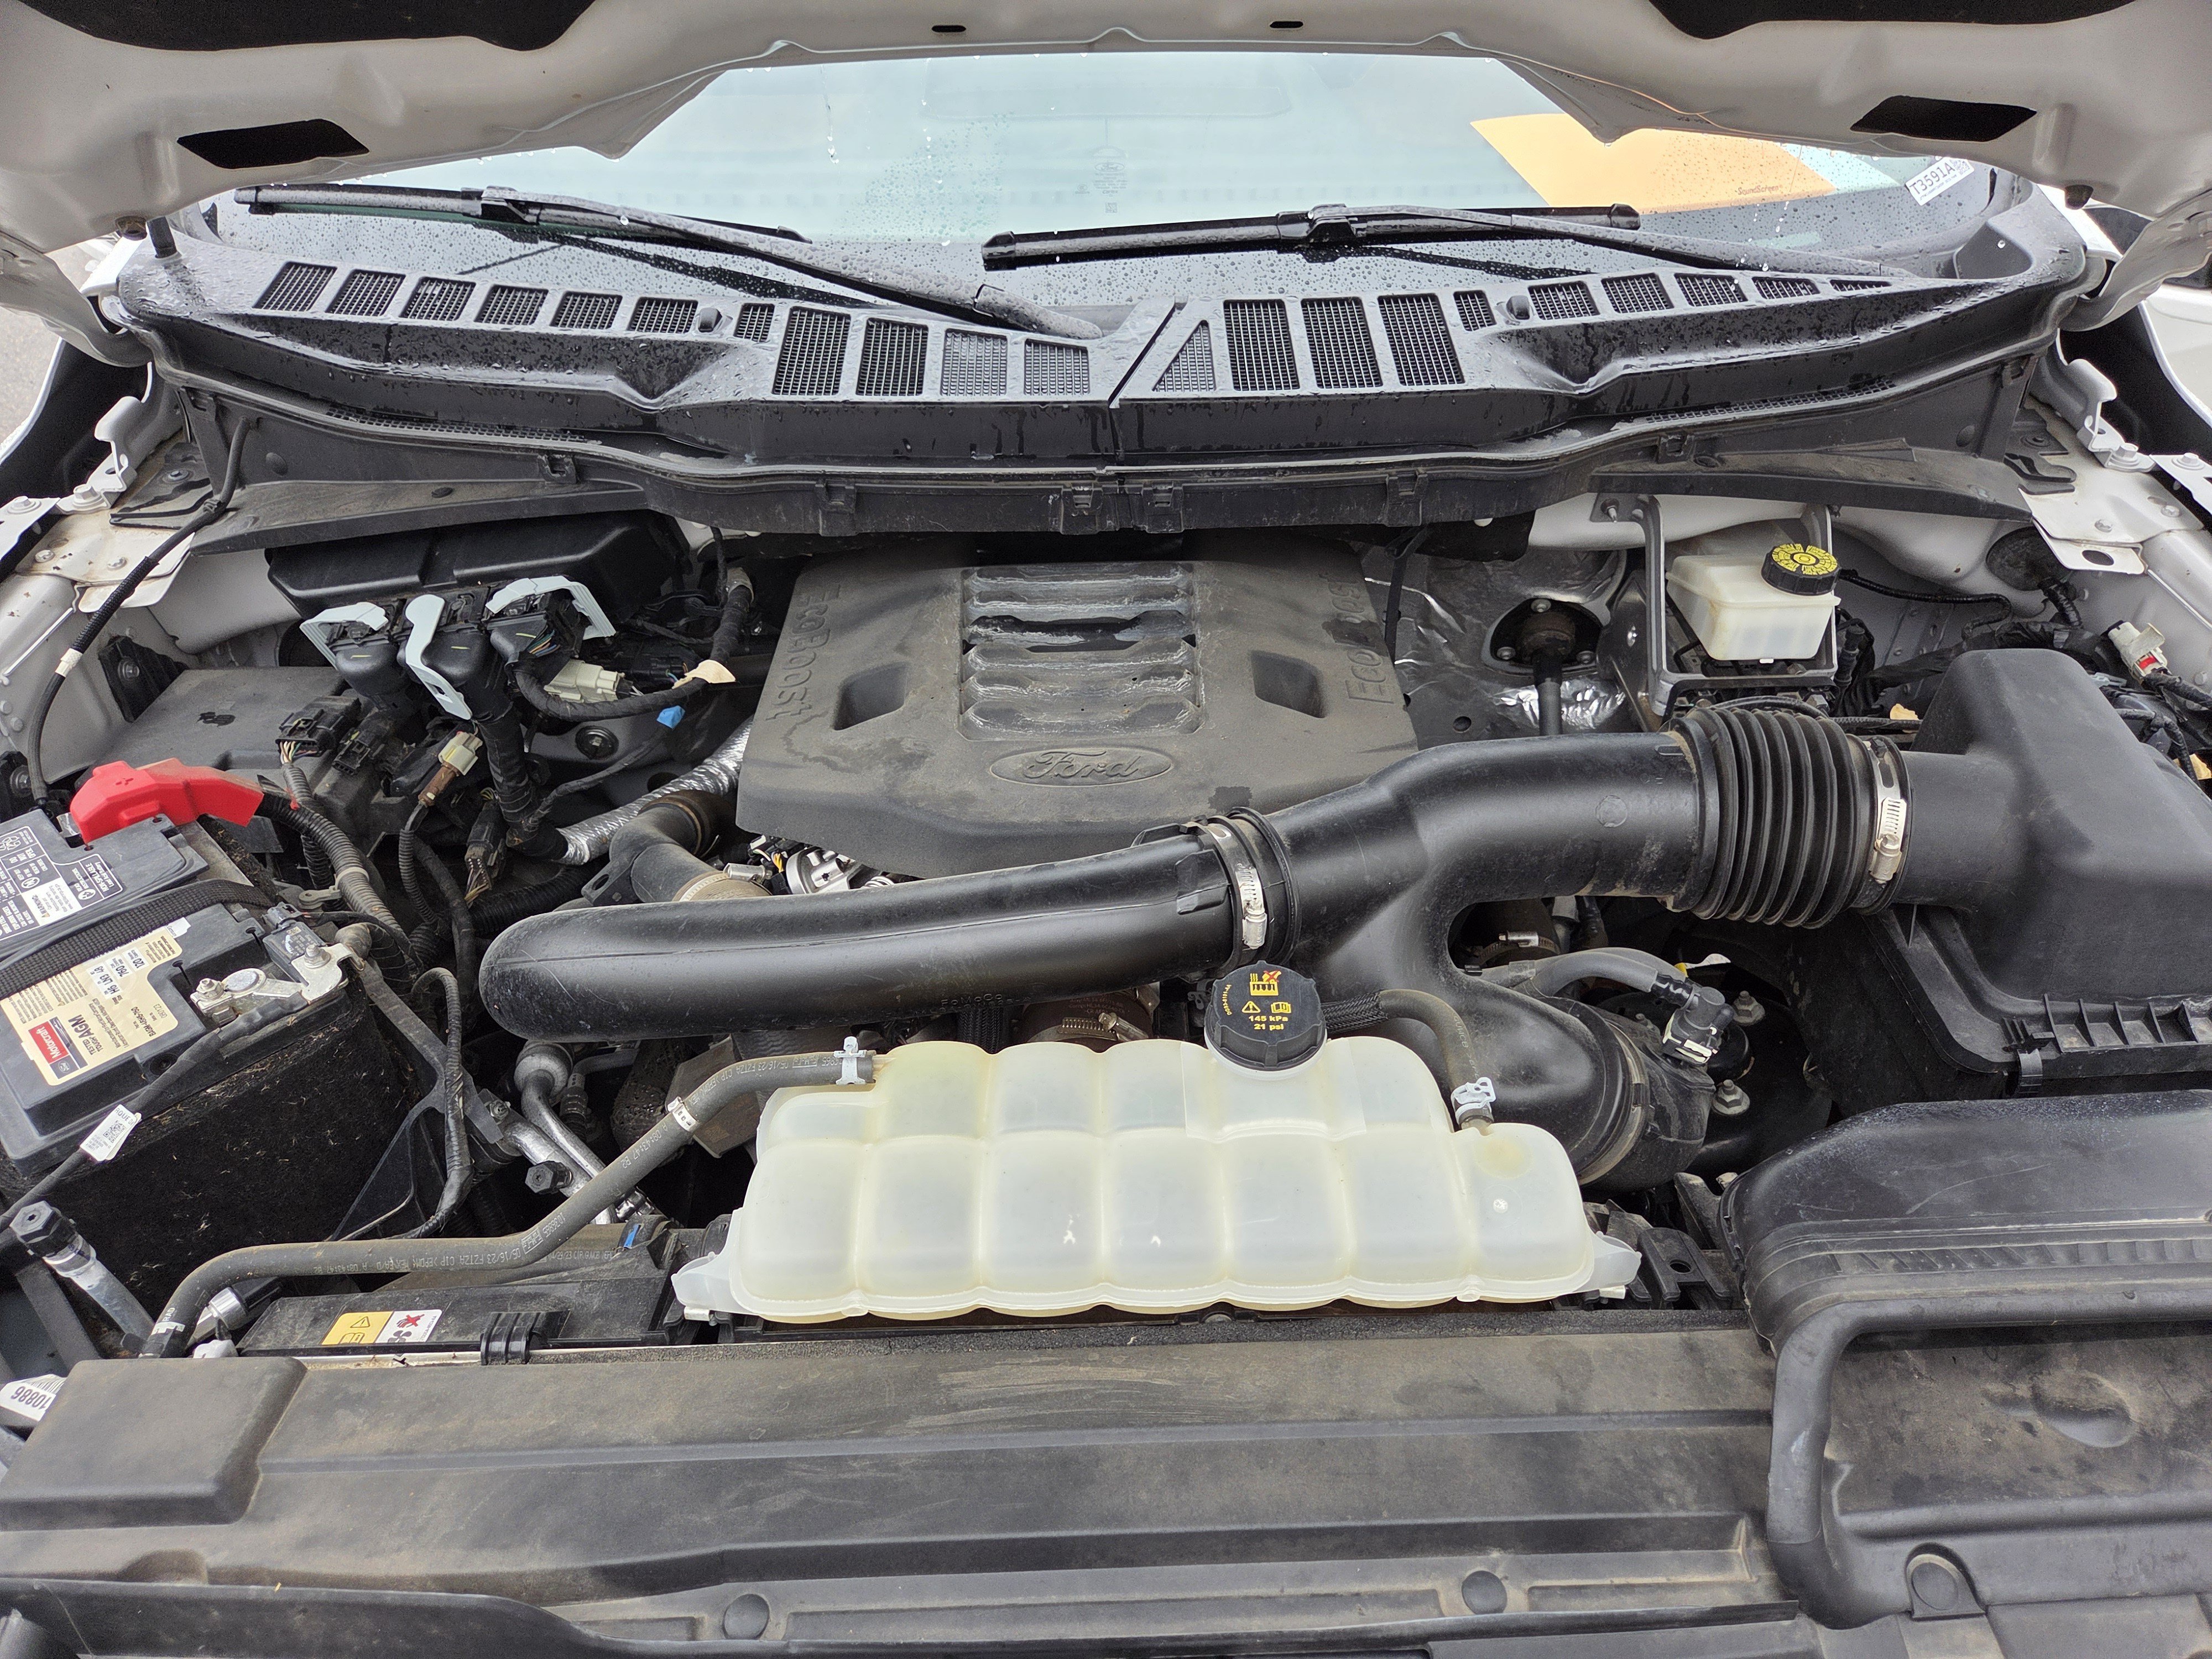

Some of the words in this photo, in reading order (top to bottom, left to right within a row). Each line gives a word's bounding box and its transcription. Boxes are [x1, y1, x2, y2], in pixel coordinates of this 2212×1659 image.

[1910, 162, 1955, 194] T3591A
[1024, 751, 1140, 779] Ford
[116, 965, 128, 976] 760
[133, 958, 145, 968] 120
[100, 973, 112, 985] LN3
[107, 984, 119, 994] H6
[941, 993, 1002, 1005] FoMoCo
[67, 1014, 93, 1038] AGM
[36, 1026, 61, 1058] Motorcraft
[82, 1039, 96, 1055] TESTED
[633, 1130, 662, 1160] 08:43:47
[620, 1156, 632, 1168] B2
[441, 1256, 455, 1266] CIP
[487, 1248, 521, 1264] 05/16/23
[162, 1307, 175, 1321] RAD
[11, 1386, 52, 1410] 10886
